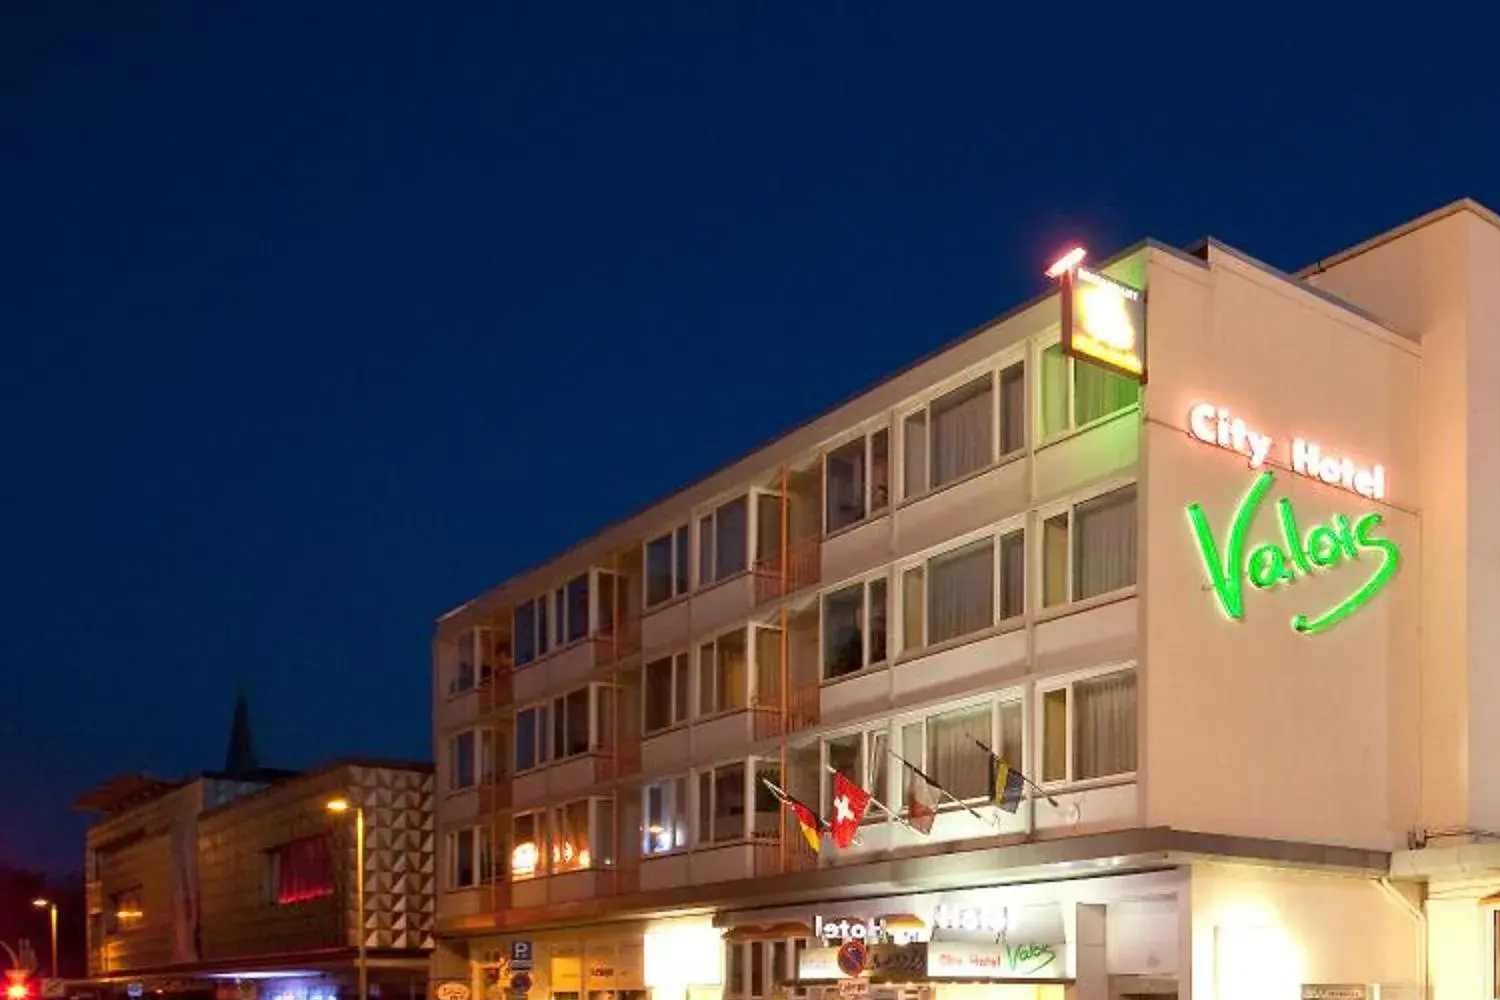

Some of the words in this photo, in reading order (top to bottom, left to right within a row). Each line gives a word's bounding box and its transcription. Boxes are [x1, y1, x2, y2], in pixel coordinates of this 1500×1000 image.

[1190, 404, 1273, 469] City
[1292, 437, 1385, 499] Hotel
[1186, 470, 1400, 633] Valois
